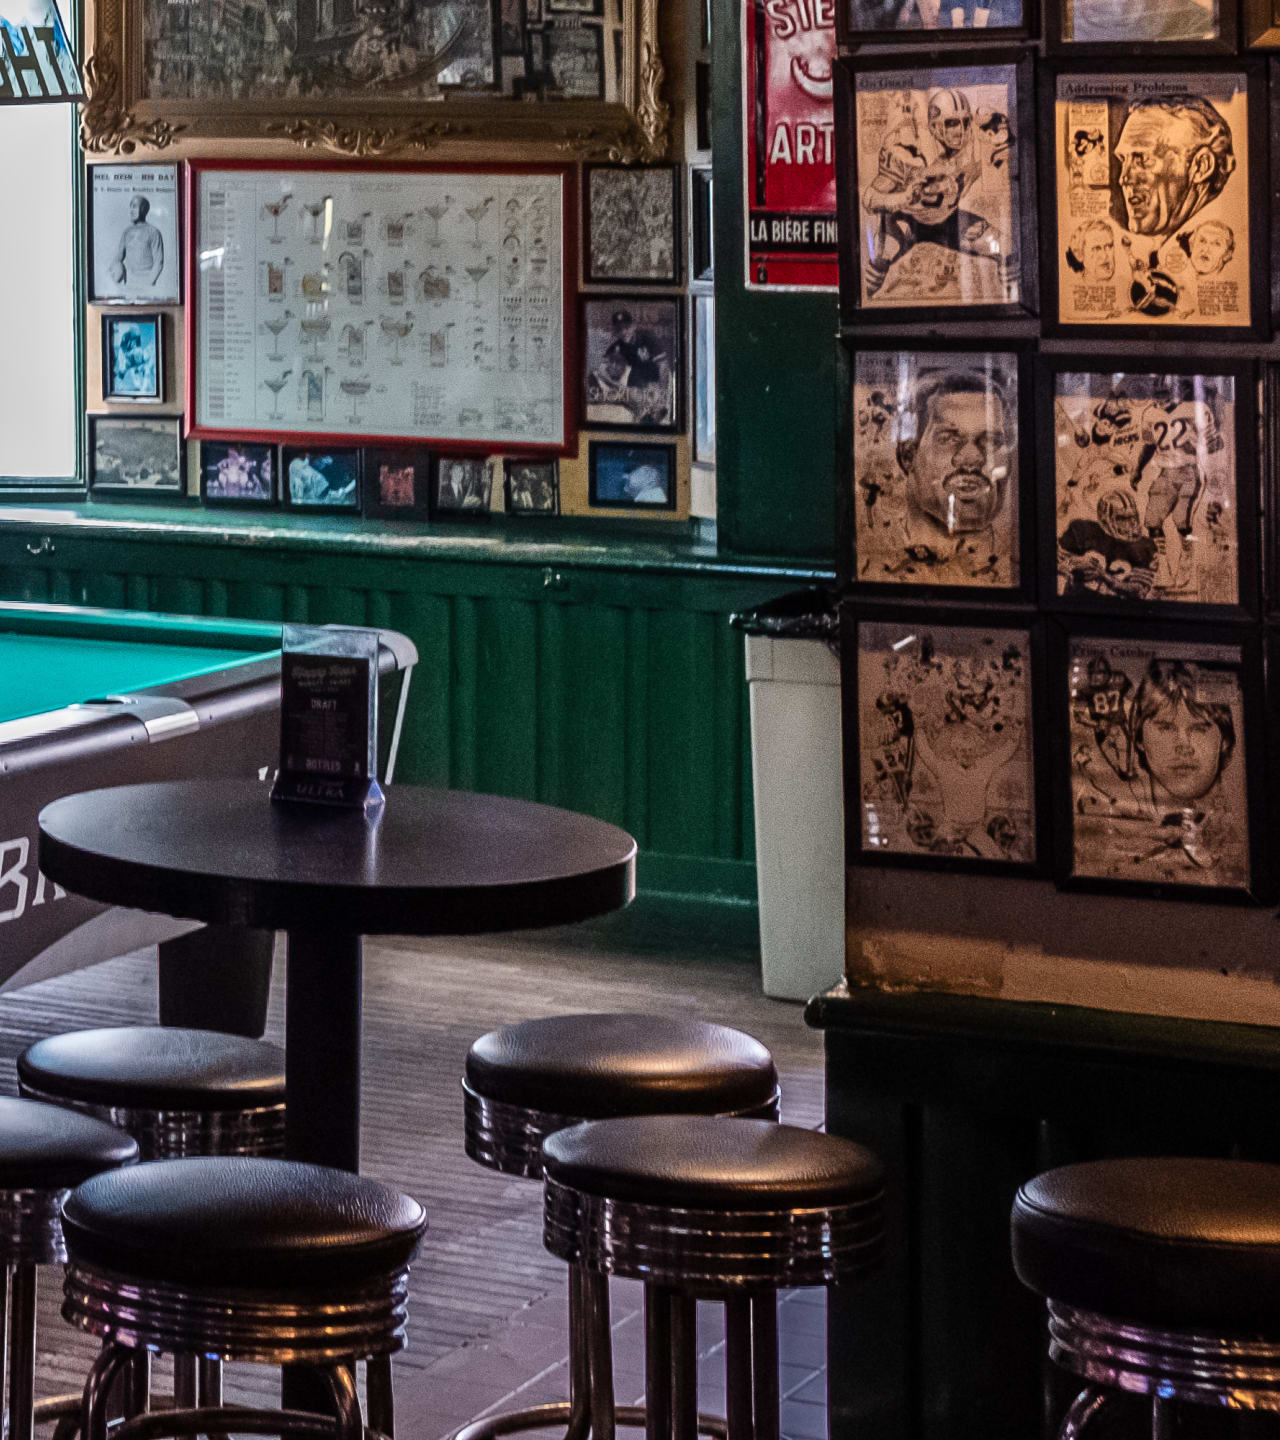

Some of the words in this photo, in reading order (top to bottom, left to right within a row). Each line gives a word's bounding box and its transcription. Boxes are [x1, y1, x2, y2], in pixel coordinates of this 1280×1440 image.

[1064, 81, 1129, 95] Addressing
[1133, 81, 1189, 95] Problems
[750, 217, 768, 242] LA
[770, 212, 811, 244] BIÈRE
[1153, 417, 1190, 451] 22
[310, 697, 338, 711] DRAFT
[1093, 688, 1122, 716] 87
